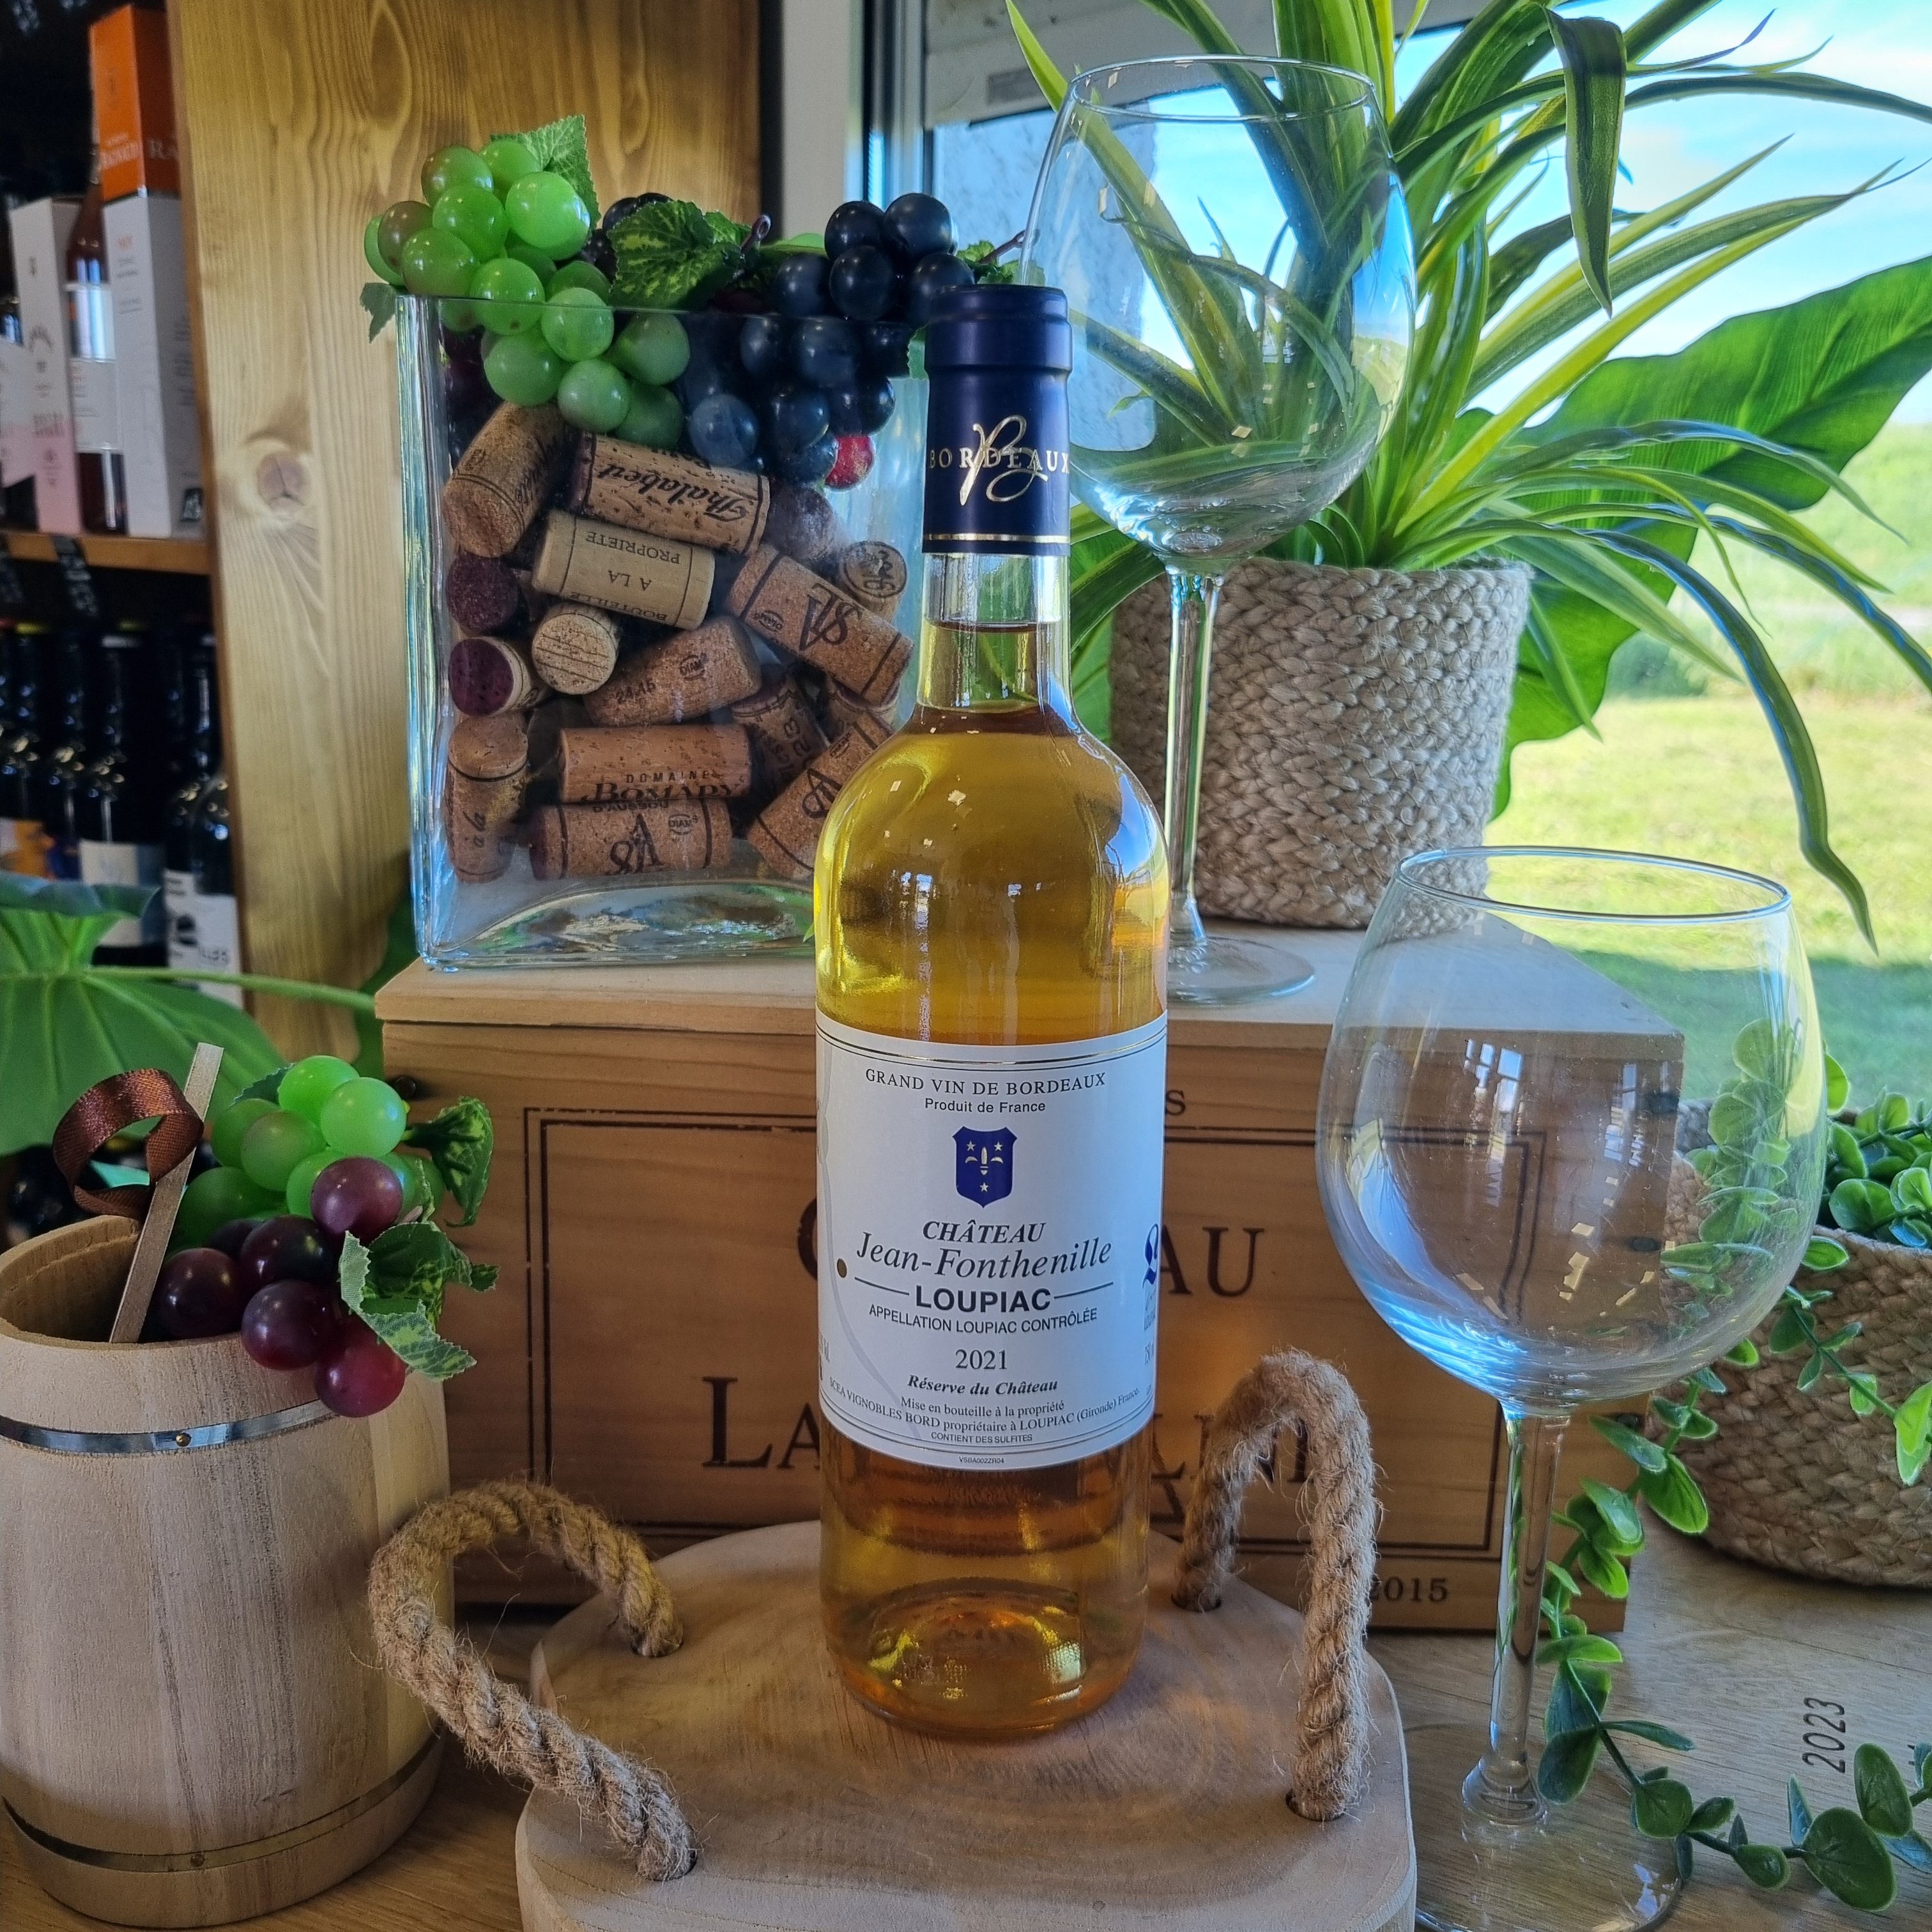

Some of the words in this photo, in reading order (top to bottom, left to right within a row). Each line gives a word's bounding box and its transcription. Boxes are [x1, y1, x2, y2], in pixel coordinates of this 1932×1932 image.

[930, 447, 1070, 475] BORDEAUX
[585, 531, 680, 565] PROPRIETE
[608, 570, 631, 587] LA
[866, 1068, 924, 1090] GRAND
[931, 1079, 966, 1094] VIN
[972, 1082, 999, 1095] DE
[1006, 1072, 1106, 1096] BORDEAUX
[925, 1098, 972, 1113] Produit
[977, 1100, 994, 1113] de
[999, 1101, 1046, 1113] France
[923, 1219, 1046, 1243] CHÂTEAU
[856, 1232, 1112, 1278] Jean-Fonthenille
[916, 1285, 1052, 1312] LOUPIAC
[869, 1304, 952, 1331] APPELLATION
[956, 1320, 1017, 1334] LOUPIAC
[1022, 1307, 1098, 1333] CONTRÔLÉE
[955, 1349, 1008, 1370] 2021
[907, 1374, 965, 1393] Réserve
[970, 1382, 989, 1395] du
[995, 1380, 1058, 1395] Château
[829, 1376, 846, 1397] SCEA
[847, 1388, 903, 1420] VIGNOBLES
[905, 1411, 940, 1427] BORD
[943, 1419, 1007, 1433] propriétaire
[1010, 1420, 1016, 1430] à
[1020, 1413, 1075, 1430] LOUPIAC
[1077, 1399, 1117, 1422] (Gironde)
[901, 1396, 926, 1411] Mise
[928, 1404, 941, 1414] en
[944, 1403, 992, 1417] bouteille
[995, 1406, 1002, 1416] à
[1005, 1406, 1015, 1416] la
[1018, 1400, 1065, 1418] propriété
[931, 1431, 973, 1443] CONTIENT
[976, 1435, 993, 1443] DES
[994, 1433, 1033, 1443] SULFITES
[1801, 1697, 1846, 1774] 2023
